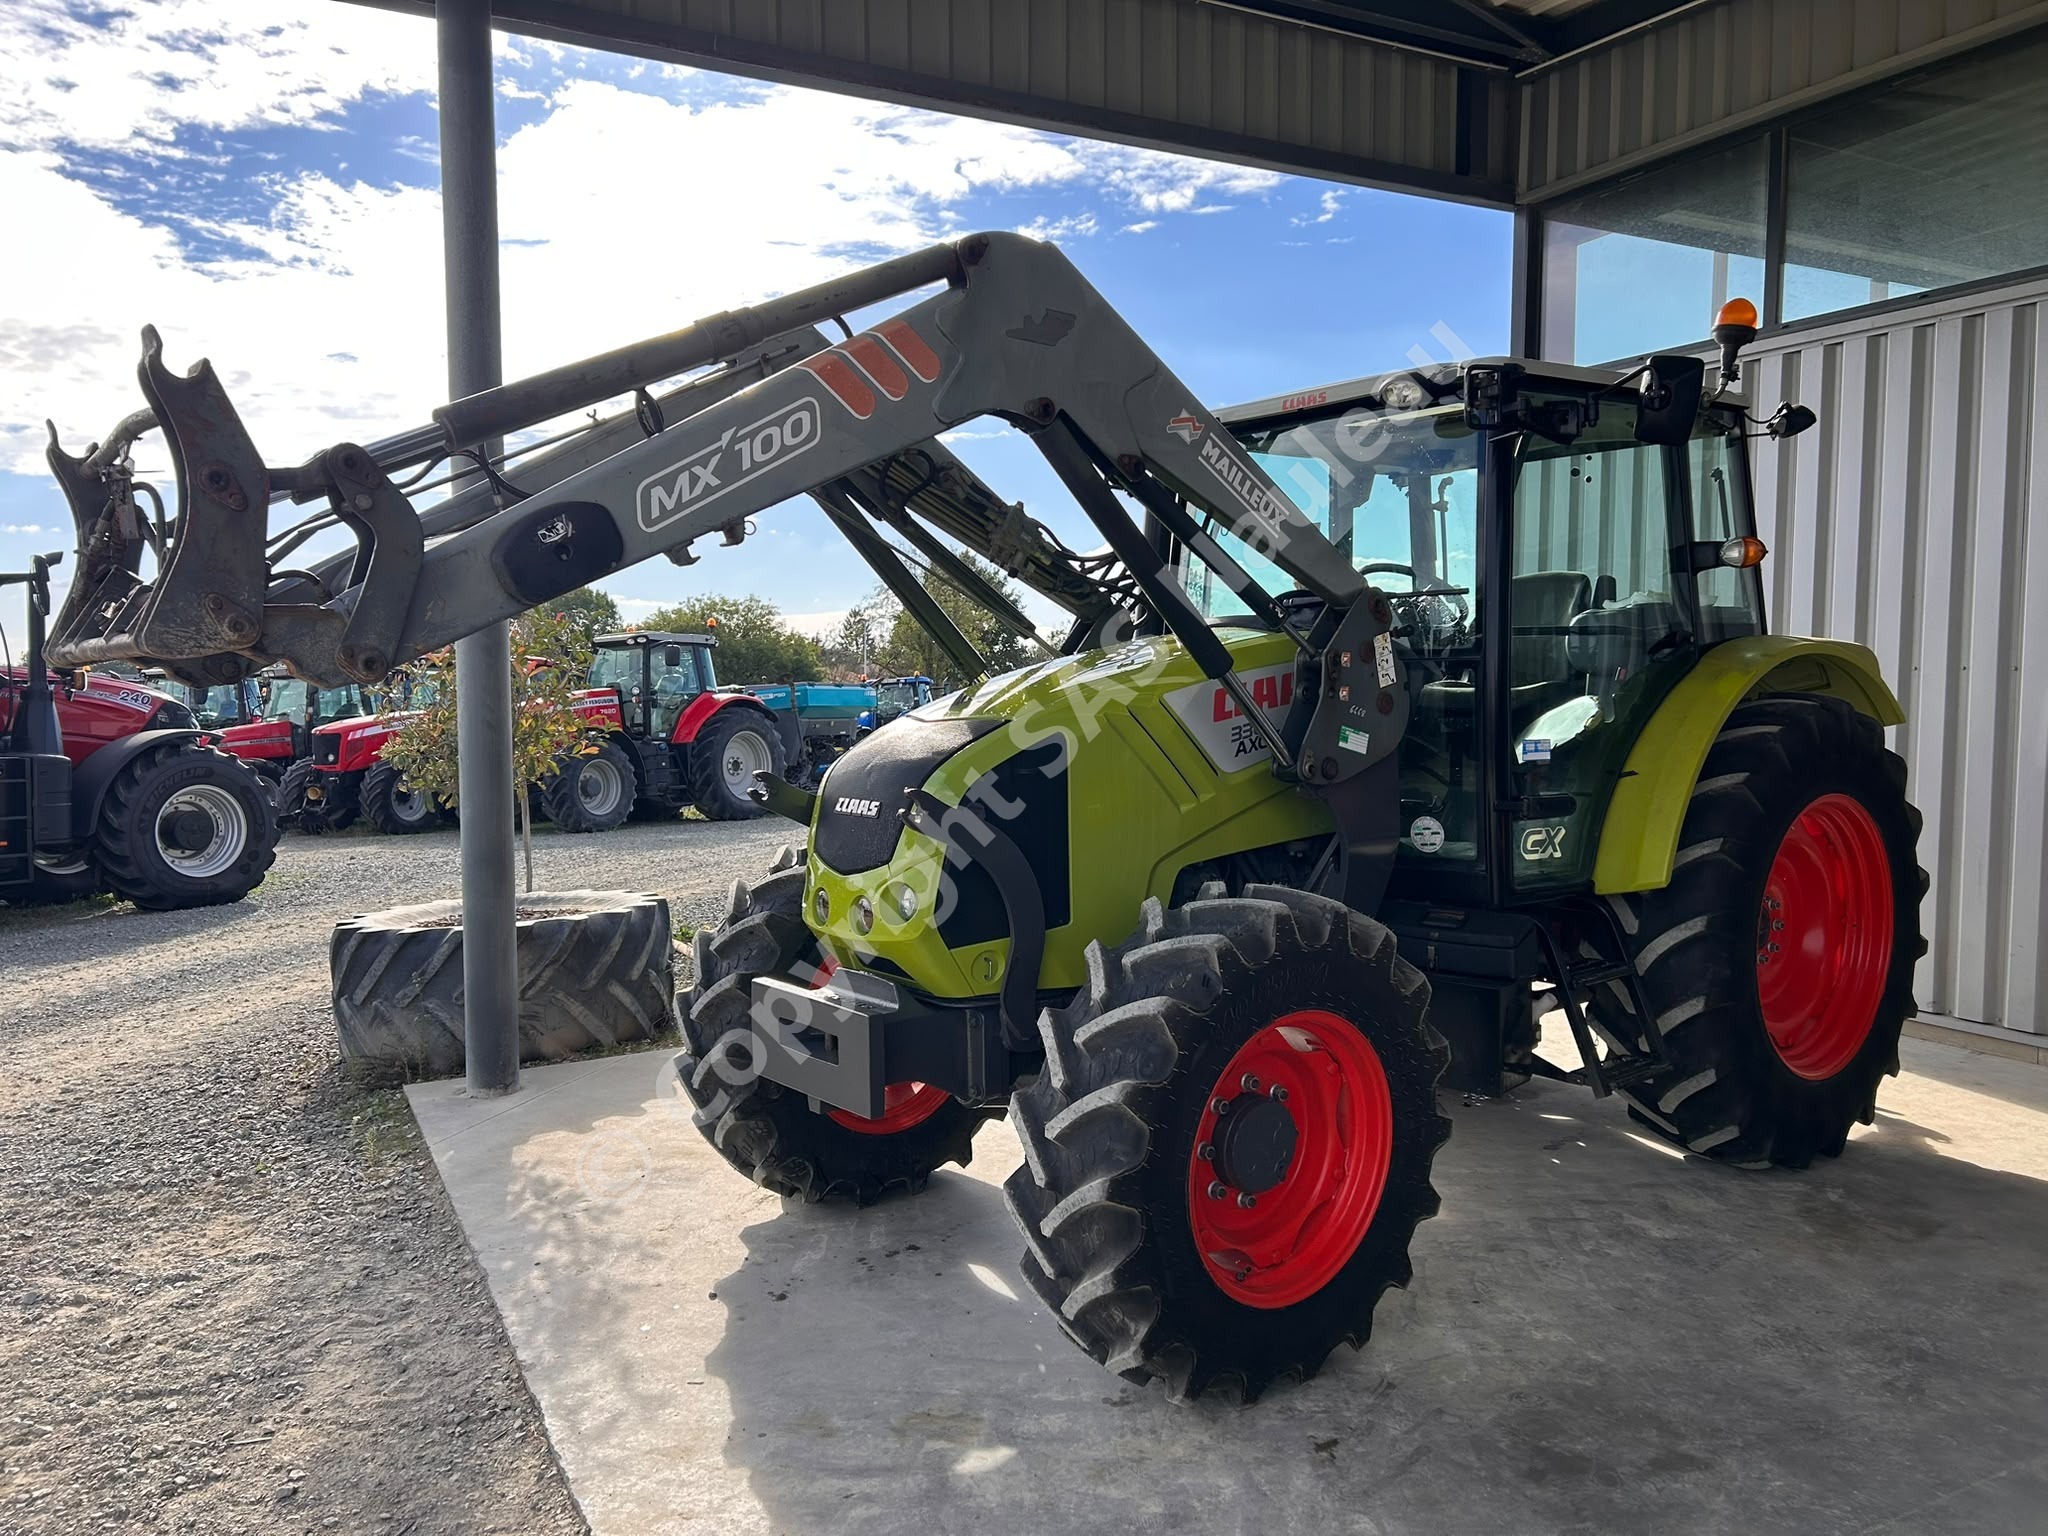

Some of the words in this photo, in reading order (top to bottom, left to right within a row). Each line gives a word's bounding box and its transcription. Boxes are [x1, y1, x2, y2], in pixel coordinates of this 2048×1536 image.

[1282, 391, 1327, 412] CLAAS
[651, 437, 732, 519] MX
[735, 410, 811, 471] 100
[1200, 438, 1287, 532] MAILLEUX
[120, 690, 152, 706] 240
[834, 797, 881, 818] CLAAS
[1521, 826, 1566, 860] CX
